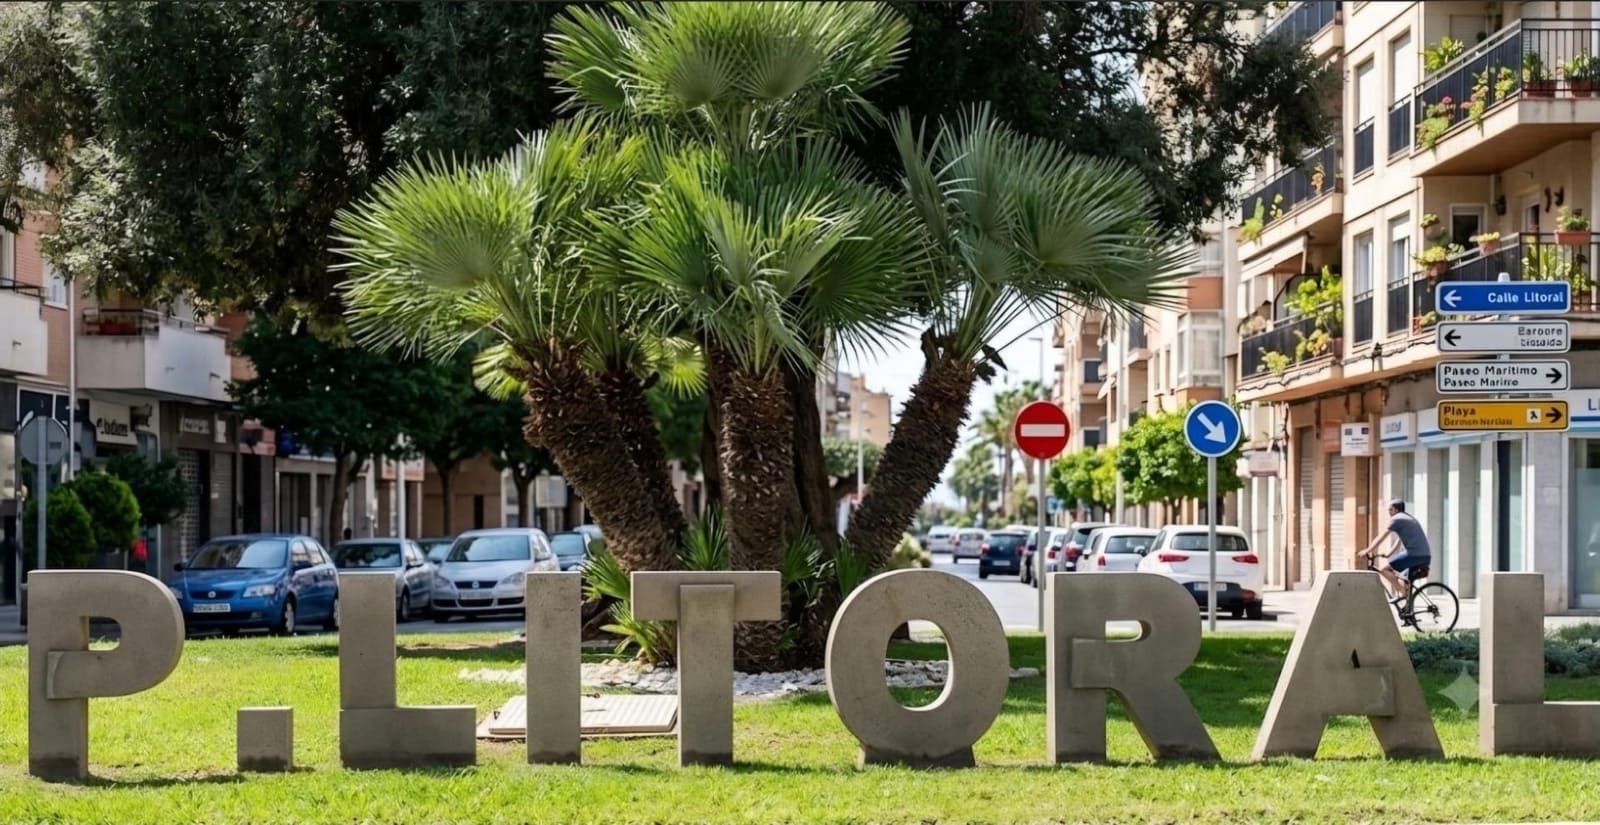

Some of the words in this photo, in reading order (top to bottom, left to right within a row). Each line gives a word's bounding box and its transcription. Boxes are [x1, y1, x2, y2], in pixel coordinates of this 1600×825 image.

[1487, 292, 1519, 303] Calle
[1524, 291, 1564, 303] Litoral
[1443, 366, 1480, 376] Paseo
[1443, 378, 1476, 387] Paseo
[1443, 406, 1476, 417] Playa
